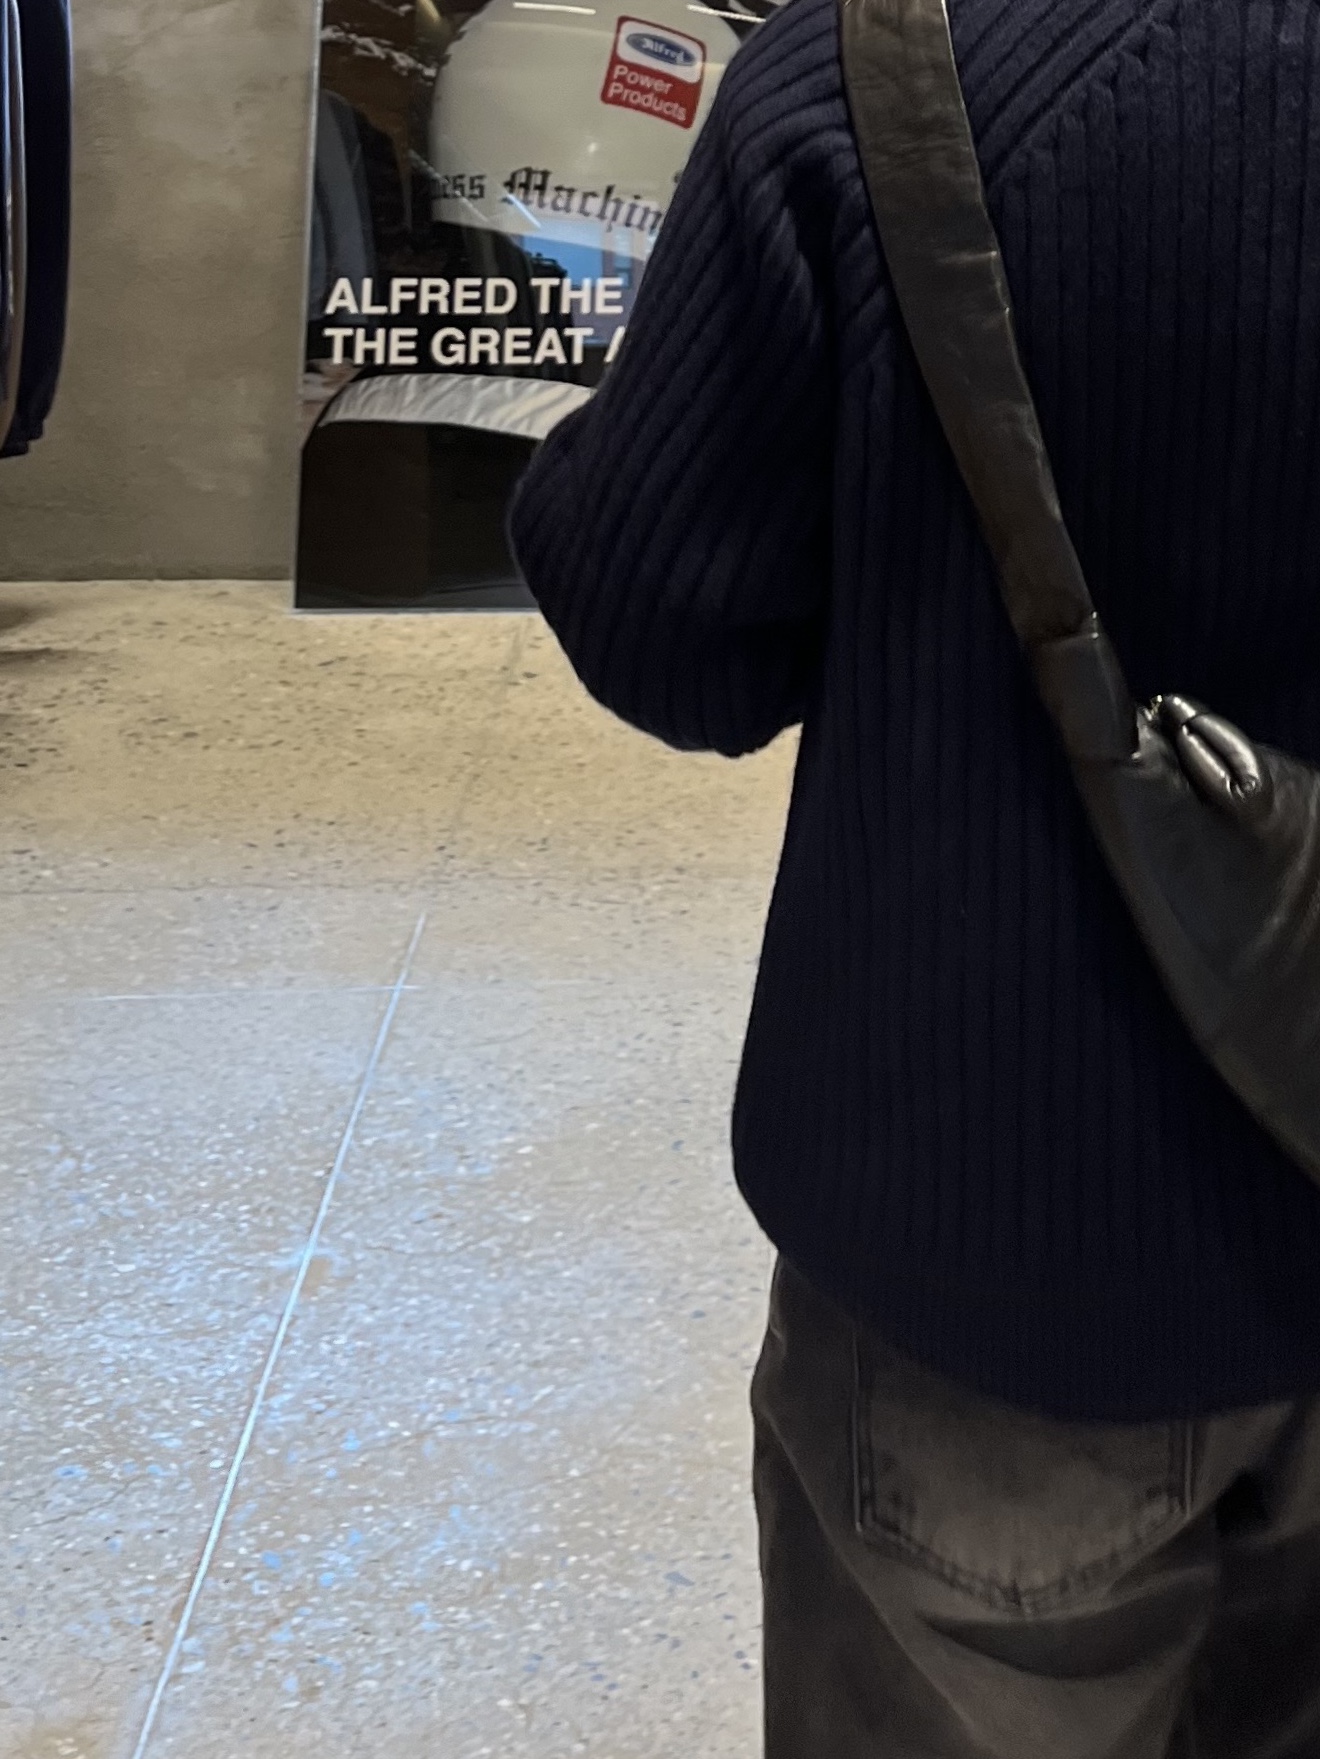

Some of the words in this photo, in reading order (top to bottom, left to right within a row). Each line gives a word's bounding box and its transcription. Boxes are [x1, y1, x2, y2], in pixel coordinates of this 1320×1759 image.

[640, 37, 685, 63] Alfred
[613, 64, 674, 95] Power
[607, 82, 687, 122] Products
[324, 277, 518, 315] ALFRED
[530, 277, 624, 315] THE
[323, 327, 418, 365] THE
[431, 326, 594, 366] GREAT
